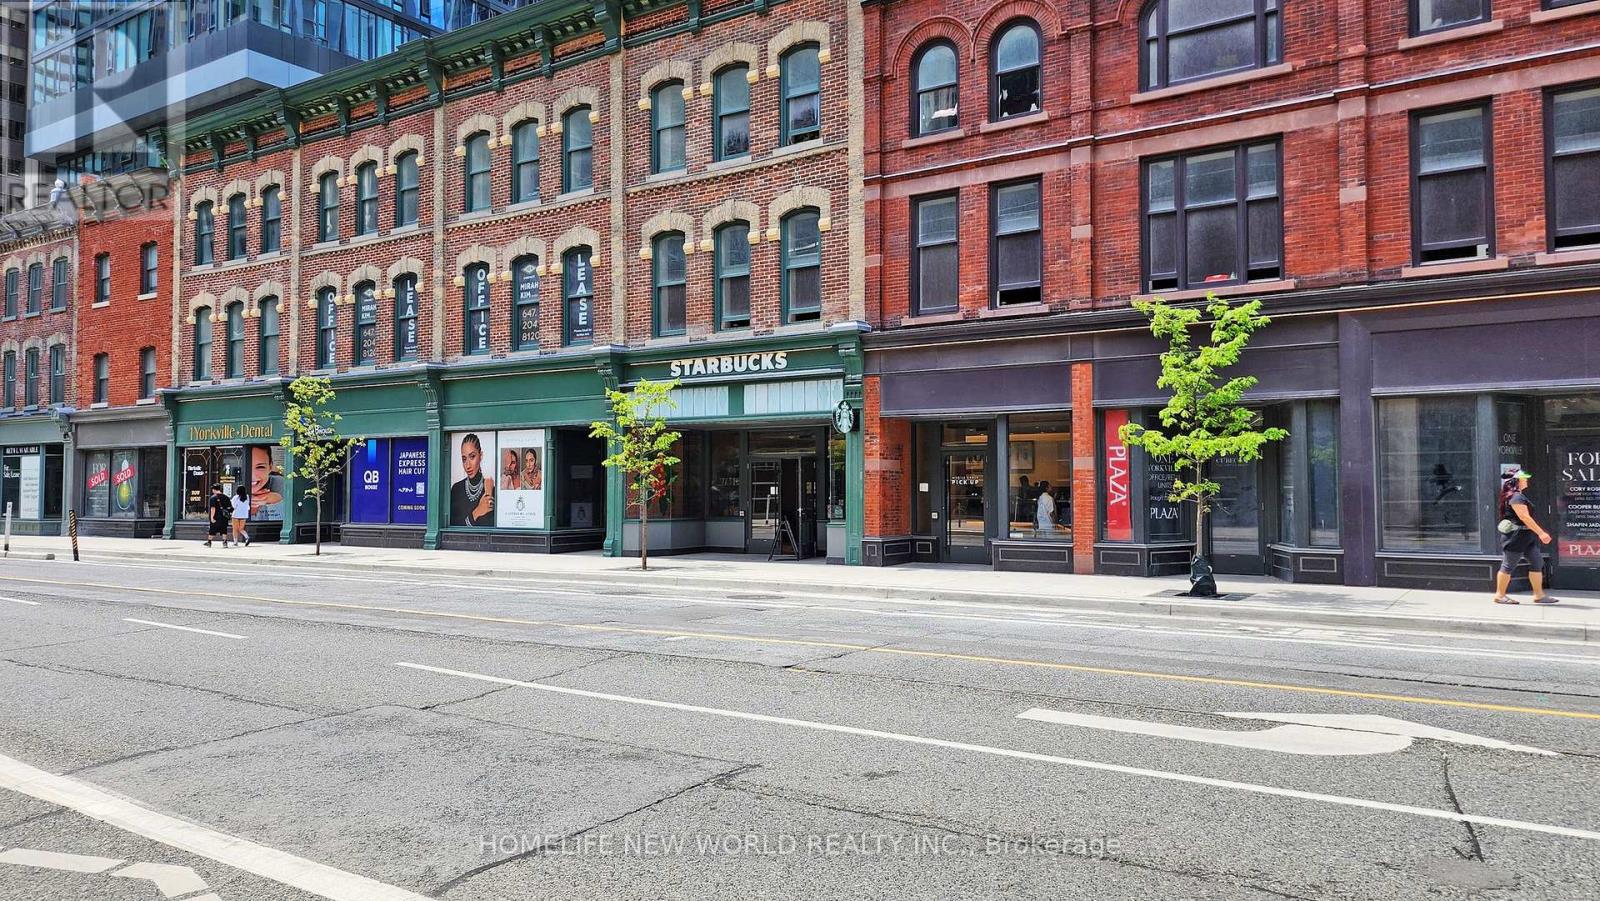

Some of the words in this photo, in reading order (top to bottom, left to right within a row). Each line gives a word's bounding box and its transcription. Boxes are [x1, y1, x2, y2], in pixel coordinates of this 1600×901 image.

[520, 281, 539, 291] MIRAH
[576, 254, 588, 326] LEASE
[406, 280, 415, 343] LEASE
[477, 268, 487, 349] OFFICE
[327, 292, 336, 364] OFFICE
[670, 352, 788, 377] STARBUCKS
[241, 423, 273, 439] Dental
[91, 473, 105, 487] SOLD
[117, 468, 132, 483] SOLD
[364, 470, 379, 484] QB
[1108, 446, 1127, 505] PLAZA
[1562, 467, 1600, 481] SAL
[1151, 507, 1178, 519] PLAZA
